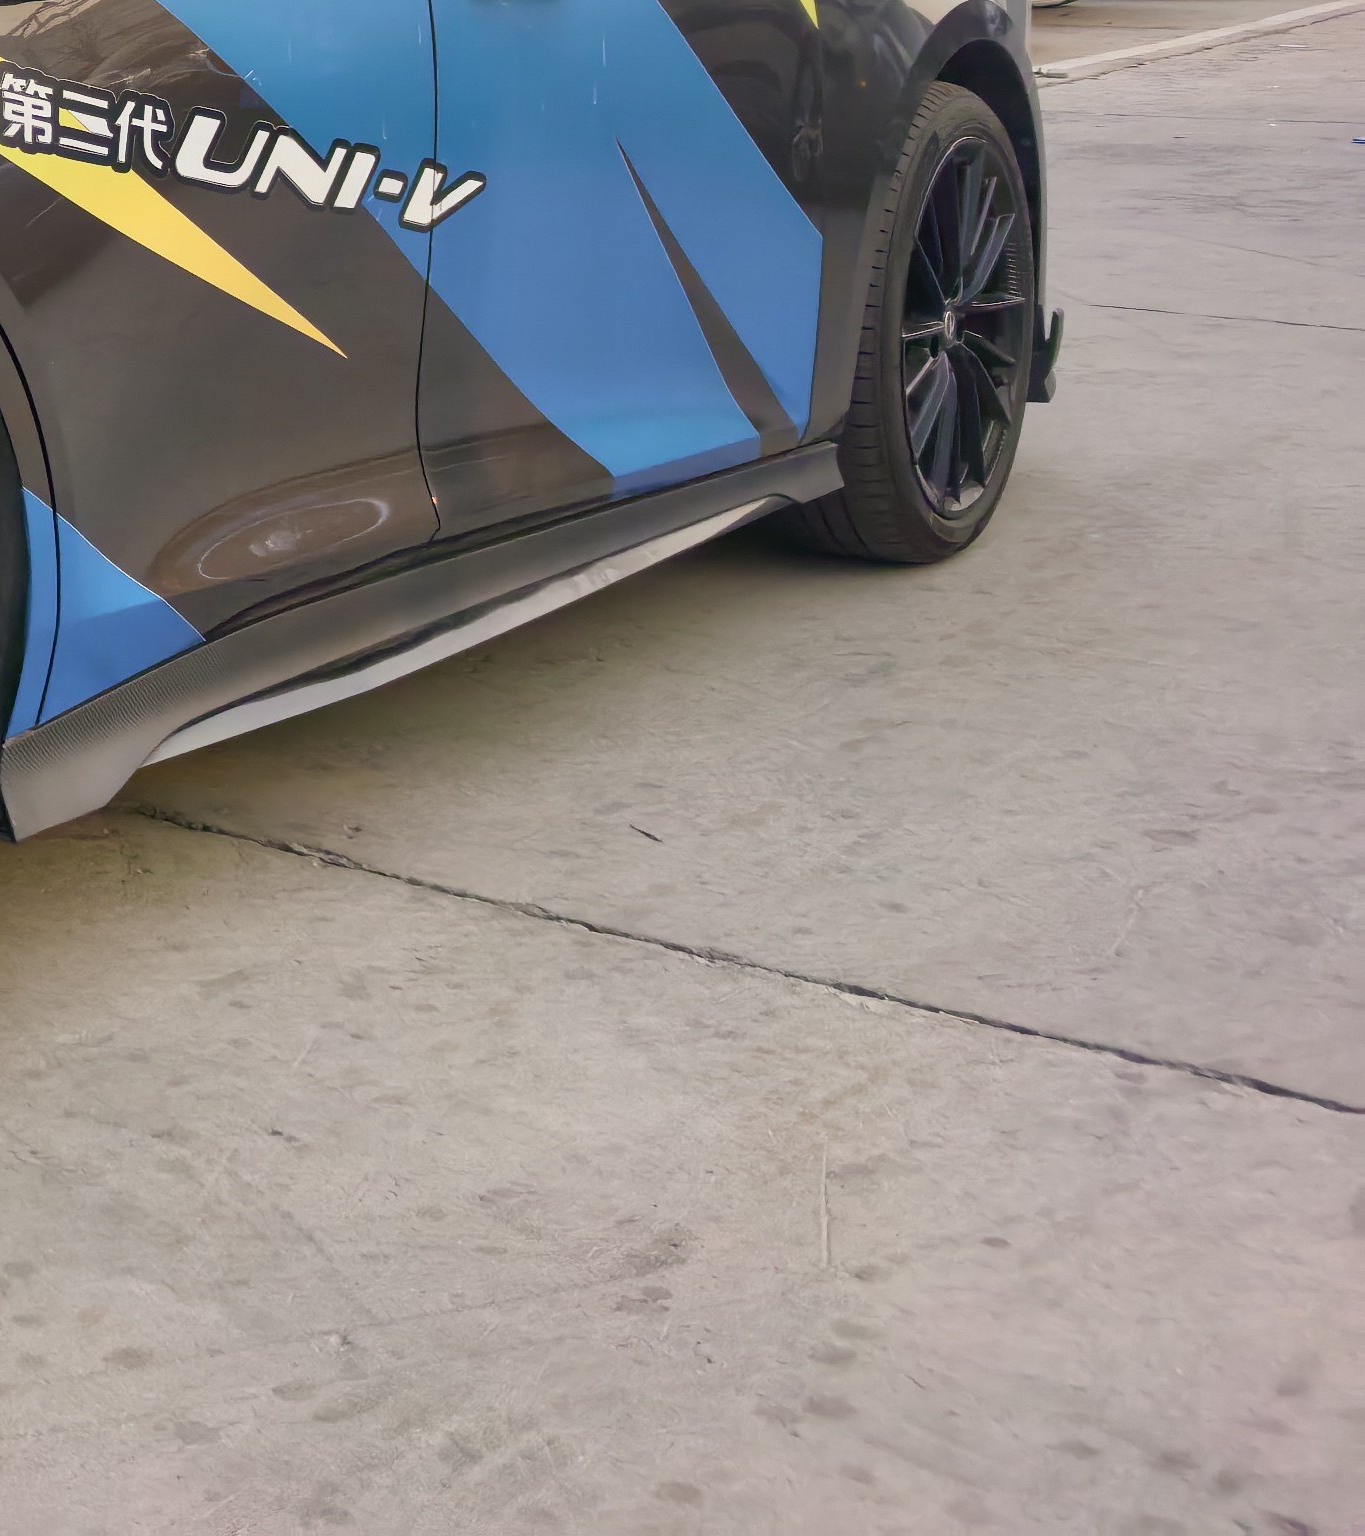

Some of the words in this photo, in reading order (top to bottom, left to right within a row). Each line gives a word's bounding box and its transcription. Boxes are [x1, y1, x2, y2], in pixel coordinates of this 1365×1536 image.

[0, 70, 169, 171] 第三代
[175, 114, 485, 227] UNI-V
